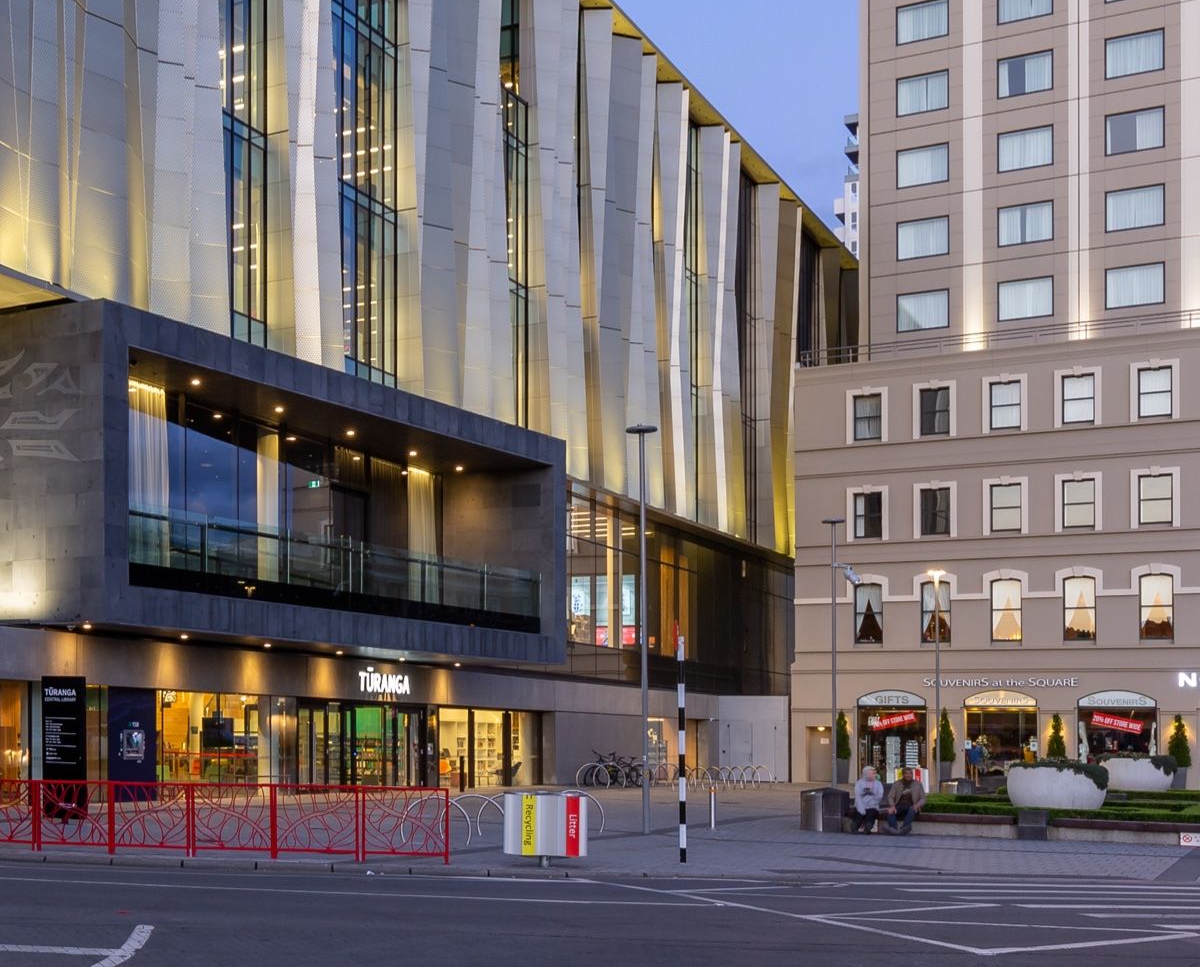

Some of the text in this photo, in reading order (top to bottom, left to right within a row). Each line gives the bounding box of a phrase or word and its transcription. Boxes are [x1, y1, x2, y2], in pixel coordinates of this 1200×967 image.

[358, 666, 410, 695] TŪRANGA
[922, 677, 1079, 688] SOUVENIRS at the SQUARE
[1178, 672, 1200, 687] N
[44, 687, 76, 696] TŪRANGA
[876, 695, 909, 704] GIFTS
[974, 696, 1029, 704] SOUVENIRS
[1087, 696, 1147, 705] SOUVENIRS
[1113, 719, 1129, 728] STORE
[523, 804, 534, 846] Recycling
[568, 814, 578, 838] Litter
